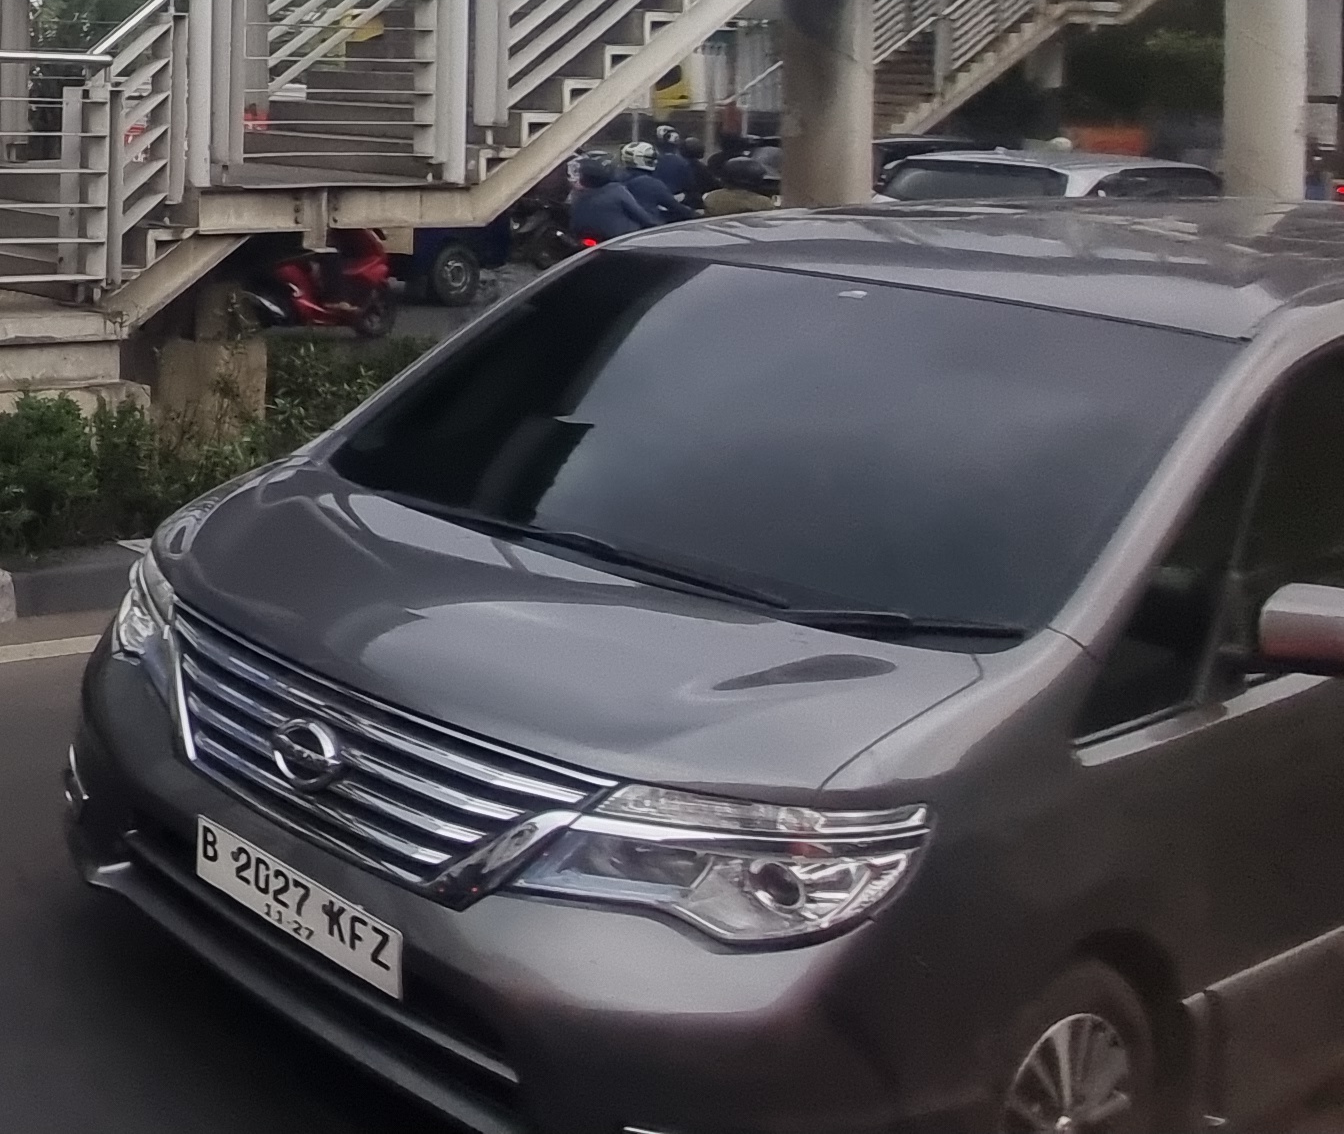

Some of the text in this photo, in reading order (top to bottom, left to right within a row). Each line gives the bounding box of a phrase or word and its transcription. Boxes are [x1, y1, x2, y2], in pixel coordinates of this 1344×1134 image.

[202, 825, 391, 972] B 2027 KFZ
